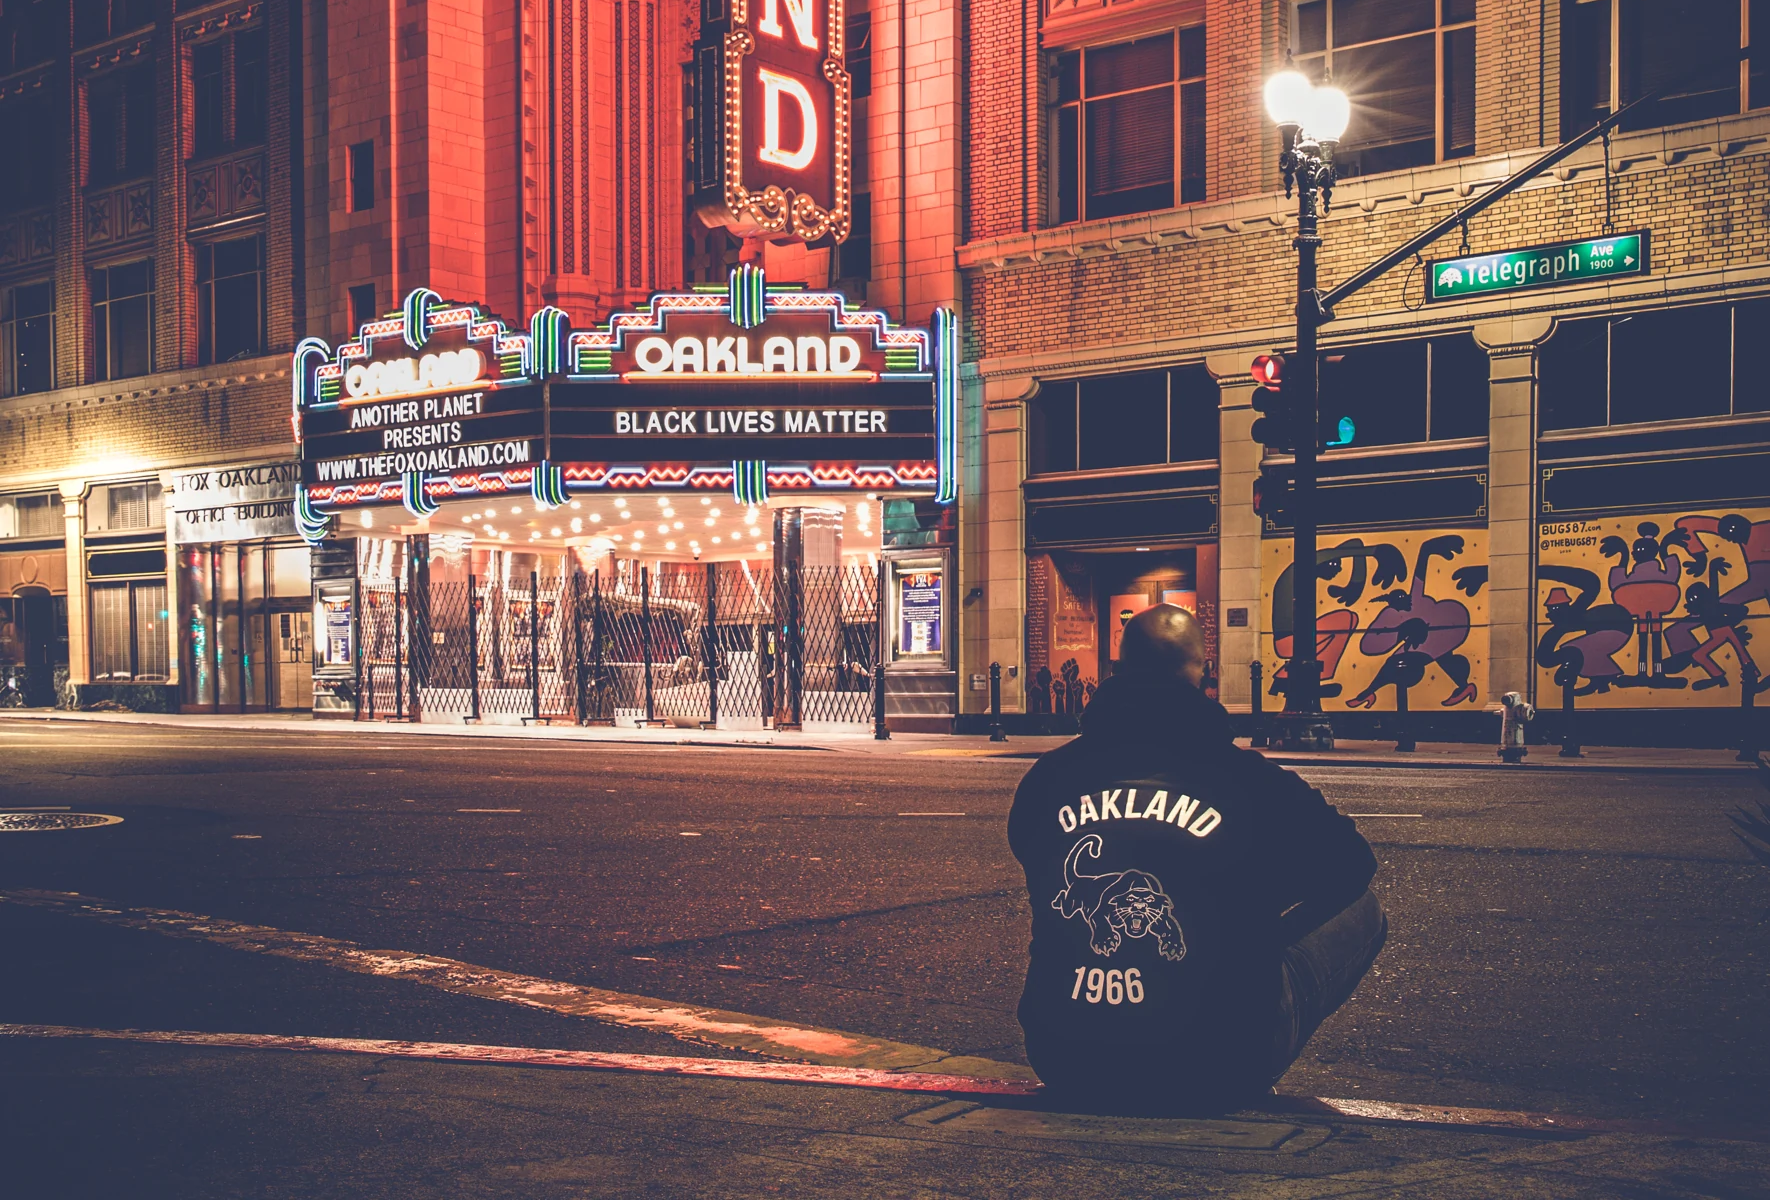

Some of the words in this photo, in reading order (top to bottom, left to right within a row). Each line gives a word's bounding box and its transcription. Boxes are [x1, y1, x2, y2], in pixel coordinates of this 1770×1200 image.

[1466, 248, 1580, 285] Telegraph
[1589, 258, 1614, 270] 1900
[1590, 244, 1614, 258] Ave
[635, 336, 861, 373] OAKLAND
[346, 348, 484, 397] OAKLAND
[351, 402, 419, 429] ANOTHER
[424, 392, 484, 419] PLANET
[616, 411, 697, 434] BLACK
[706, 411, 775, 434] LIVES
[784, 411, 887, 434] MATTER
[384, 421, 462, 449] PRESENTS
[317, 441, 529, 481] WWW.THEFOXOAKLAND.COM
[181, 473, 210, 491] FOX
[186, 507, 225, 524] OFFICE
[1540, 536, 1597, 551] @THEBUGS87
[1058, 788, 1222, 838] OAKLAND
[1071, 965, 1145, 1005] 1966
